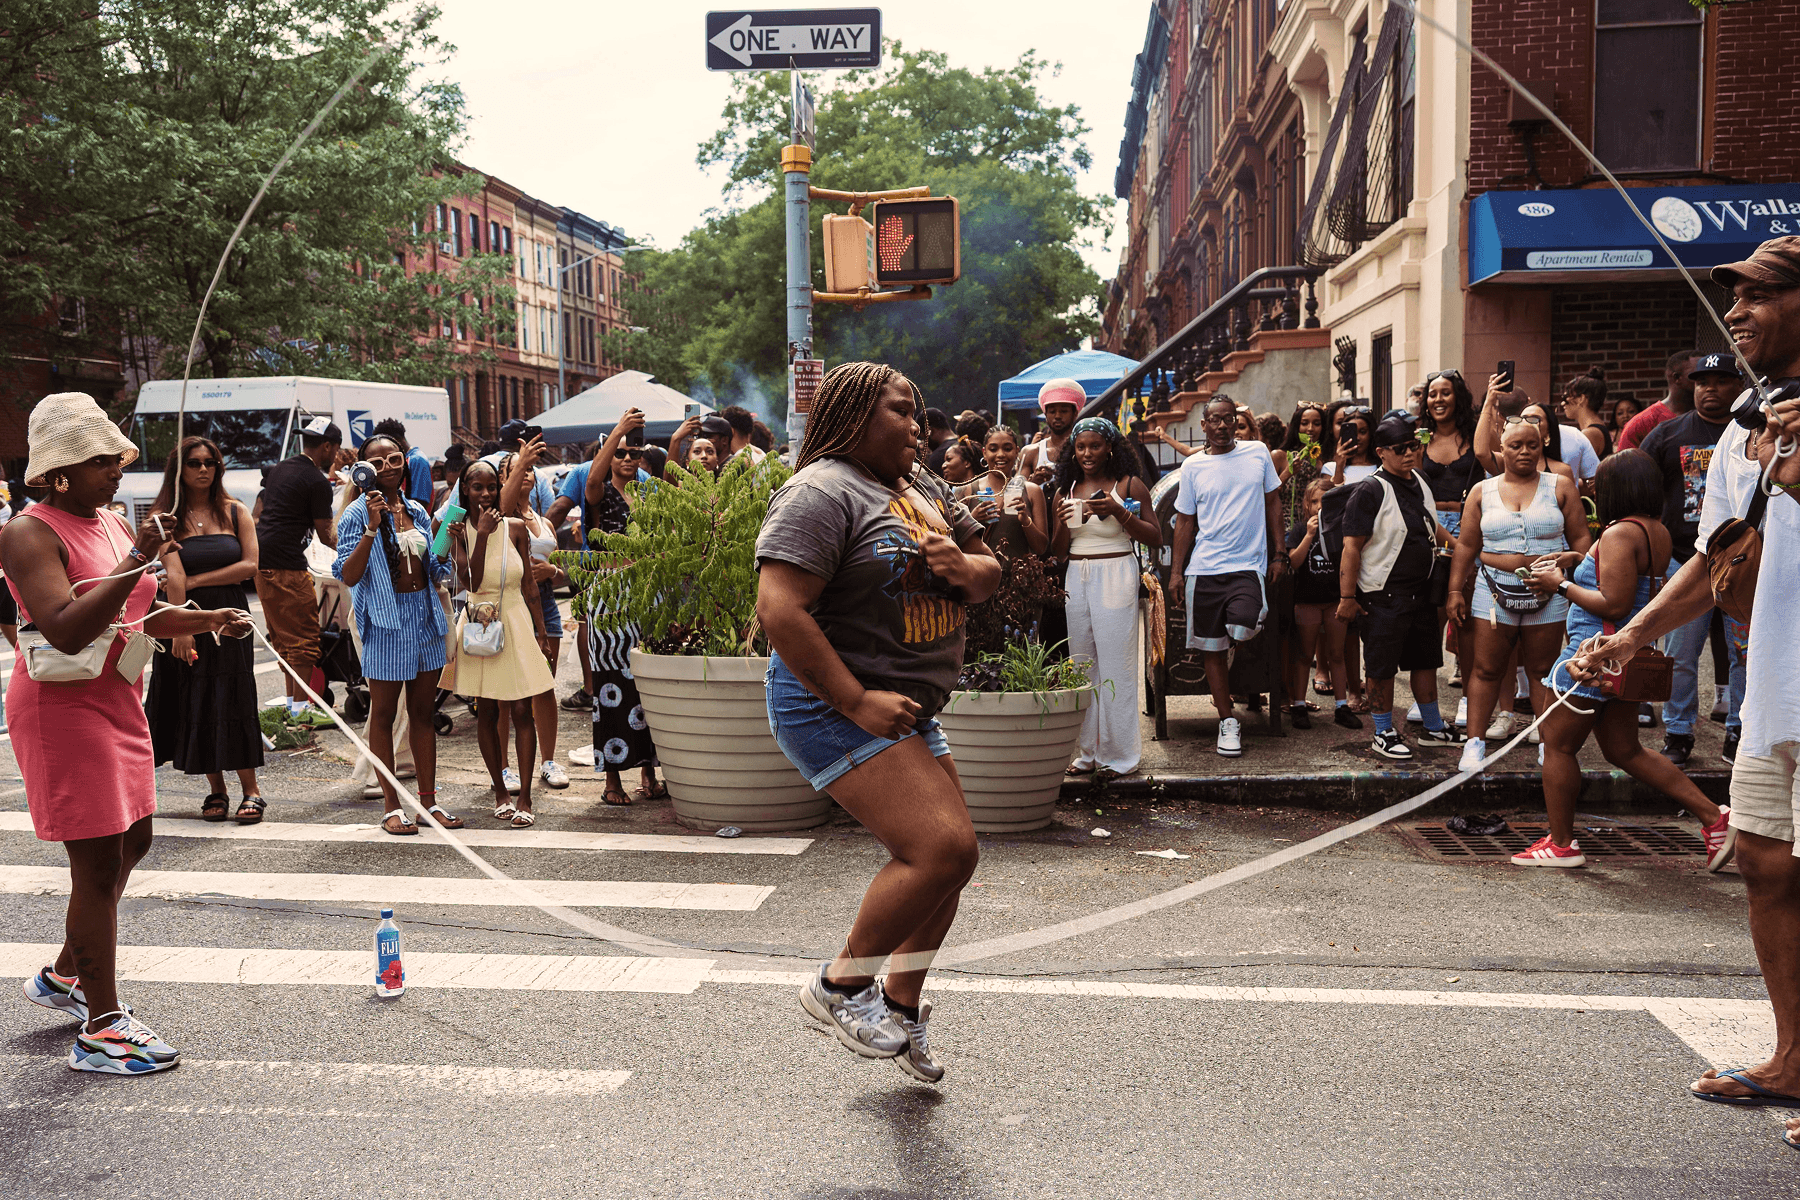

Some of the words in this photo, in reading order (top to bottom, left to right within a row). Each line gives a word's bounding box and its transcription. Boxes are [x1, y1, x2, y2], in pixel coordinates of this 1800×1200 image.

[730, 29, 780, 51] ONE
[810, 27, 864, 50] WAY
[1524, 204, 1551, 215] 386
[1769, 219, 1791, 234] &
[1536, 253, 1598, 265] Apartment
[1600, 251, 1644, 263] Rentals
[202, 391, 232, 399] 5500179
[404, 412, 410, 420] We
[411, 412, 423, 420] Deliver
[1505, 598, 1539, 609] PINK
[381, 940, 399, 955] FIJI
